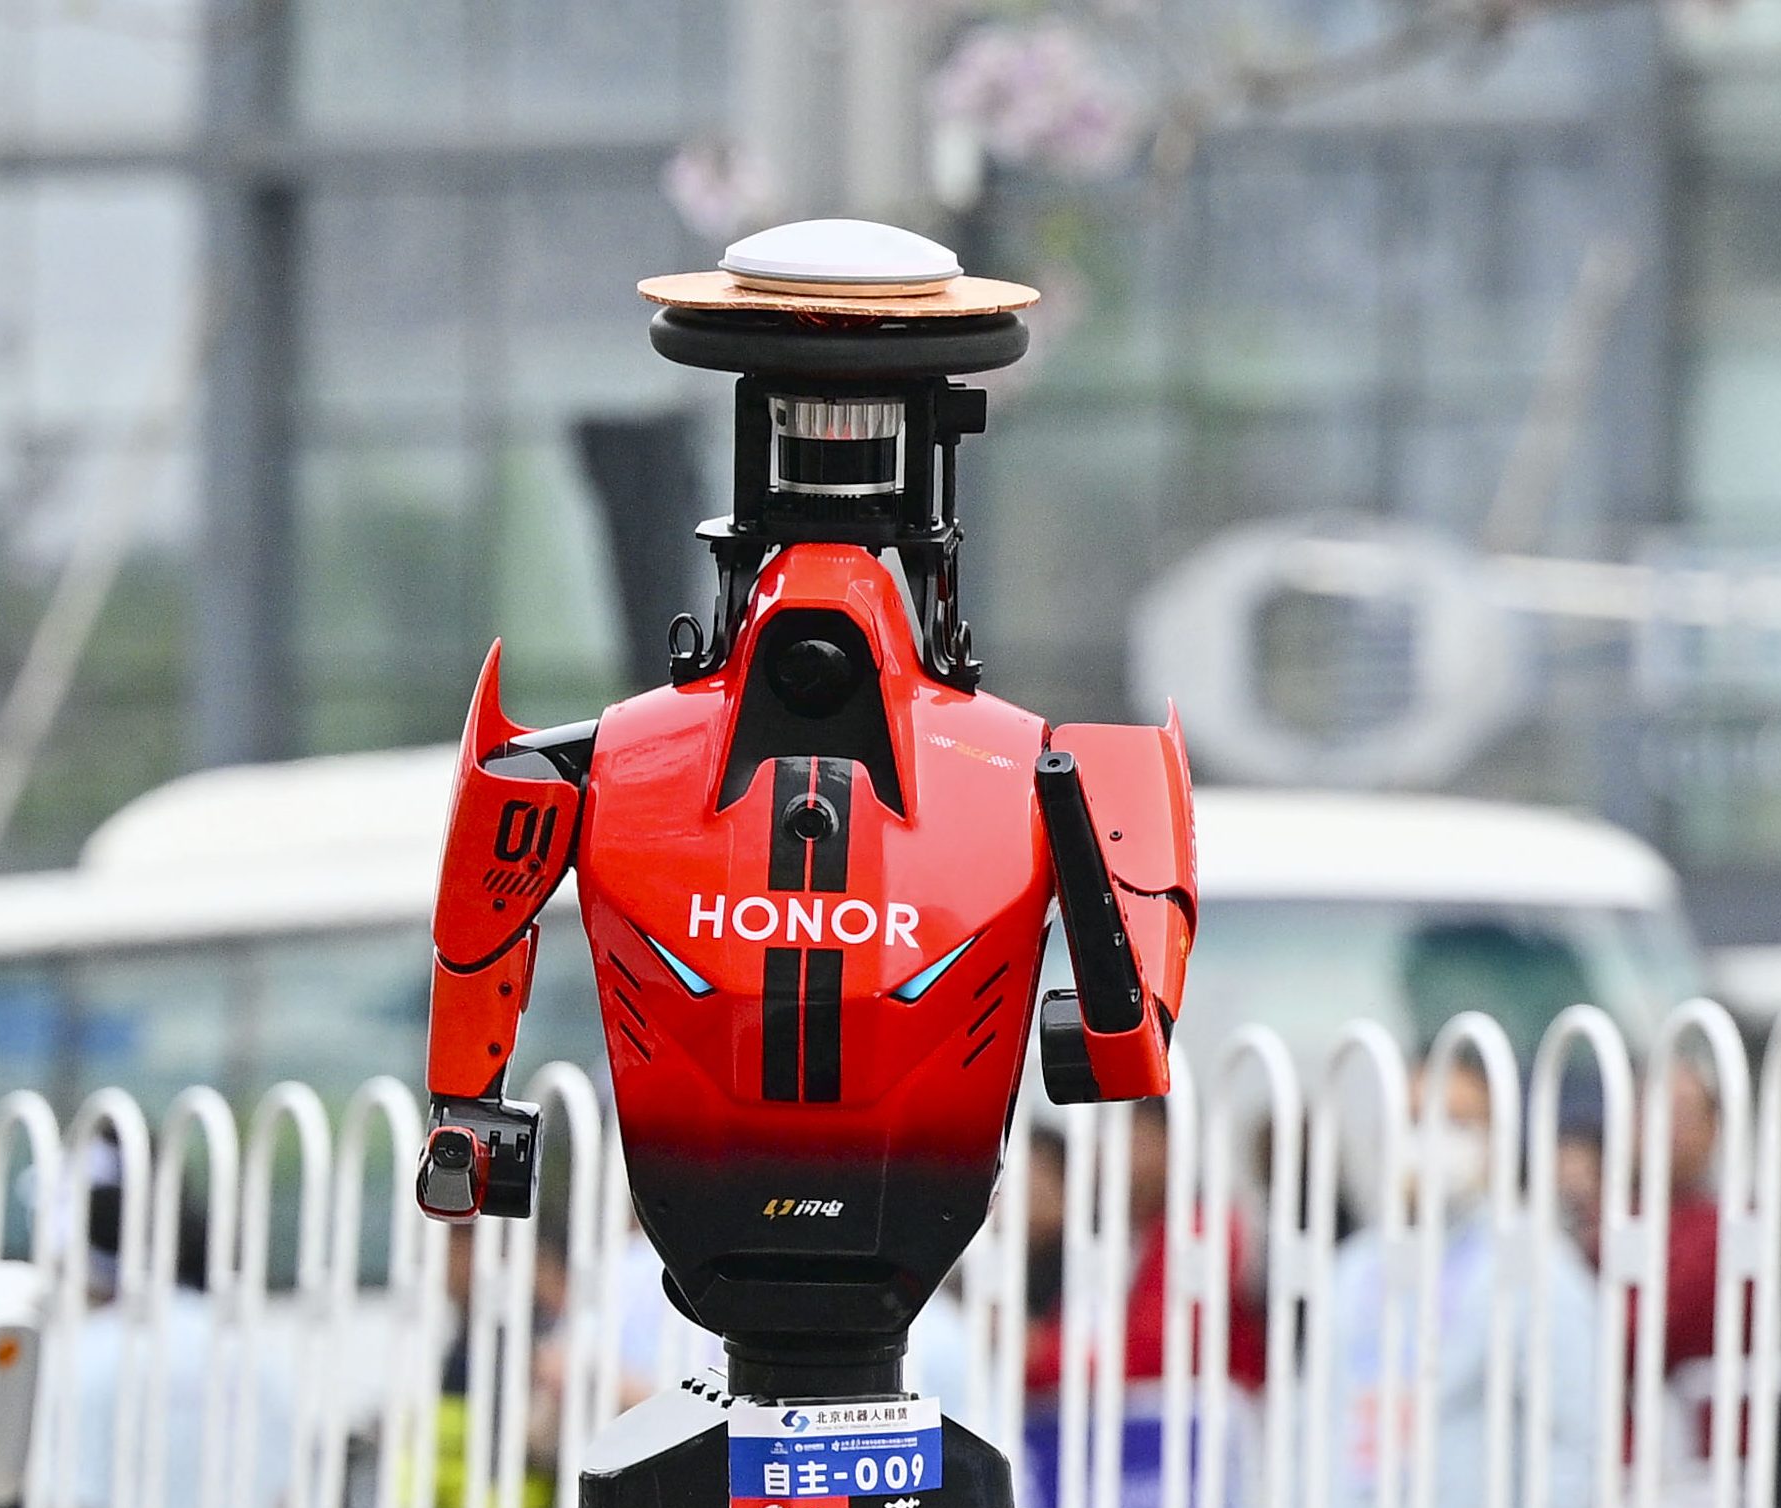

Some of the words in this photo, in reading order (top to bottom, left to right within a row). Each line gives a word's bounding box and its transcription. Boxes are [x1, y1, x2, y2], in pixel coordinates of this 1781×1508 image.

[494, 800, 558, 864] 01
[688, 893, 921, 949] HONOR
[816, 1407, 909, 1424] 北京机器人租赁
[763, 1452, 925, 1497] 自主-009
